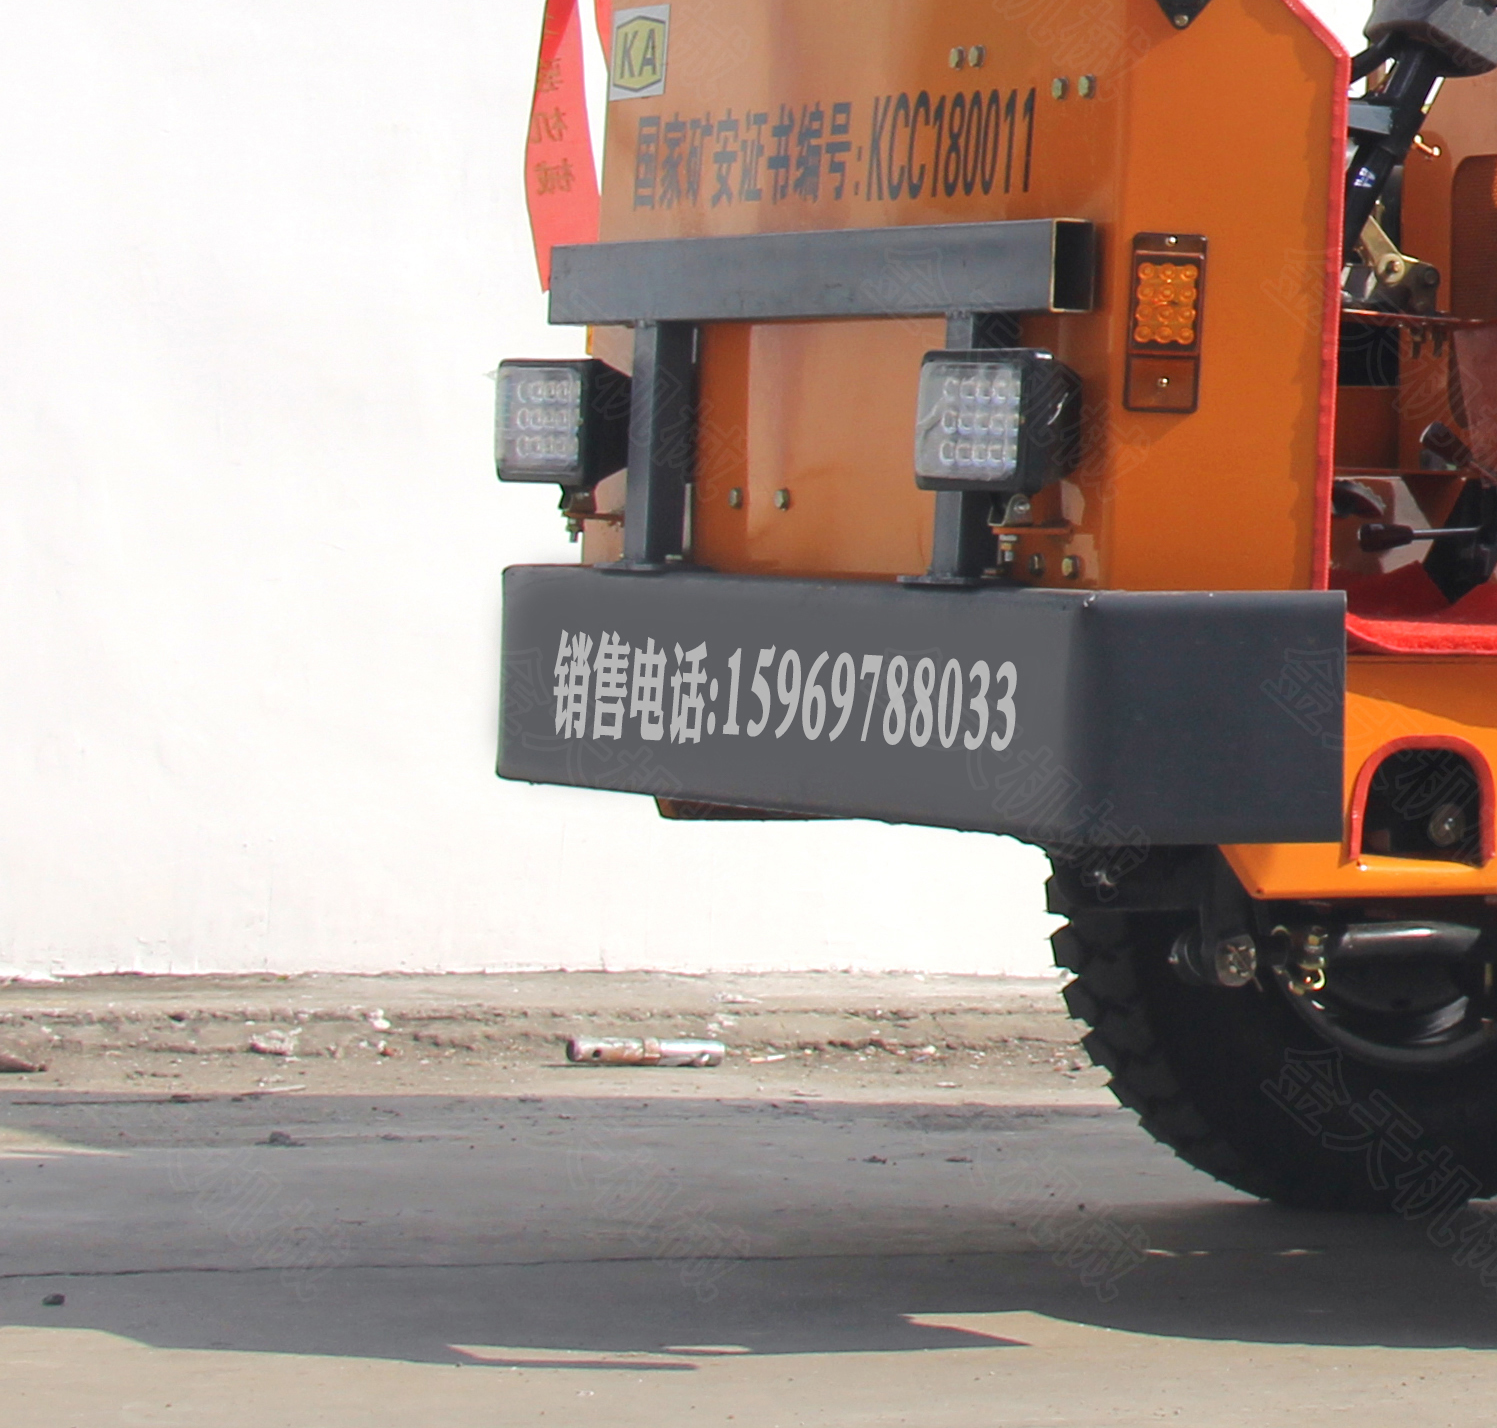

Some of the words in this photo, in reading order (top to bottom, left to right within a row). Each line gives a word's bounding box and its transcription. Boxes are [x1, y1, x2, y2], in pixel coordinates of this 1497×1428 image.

[619, 28, 658, 80] KA
[633, 87, 1036, 212] 国家矿安证书编号:KCC180011
[553, 628, 1018, 752] 销售电话:15969788033
